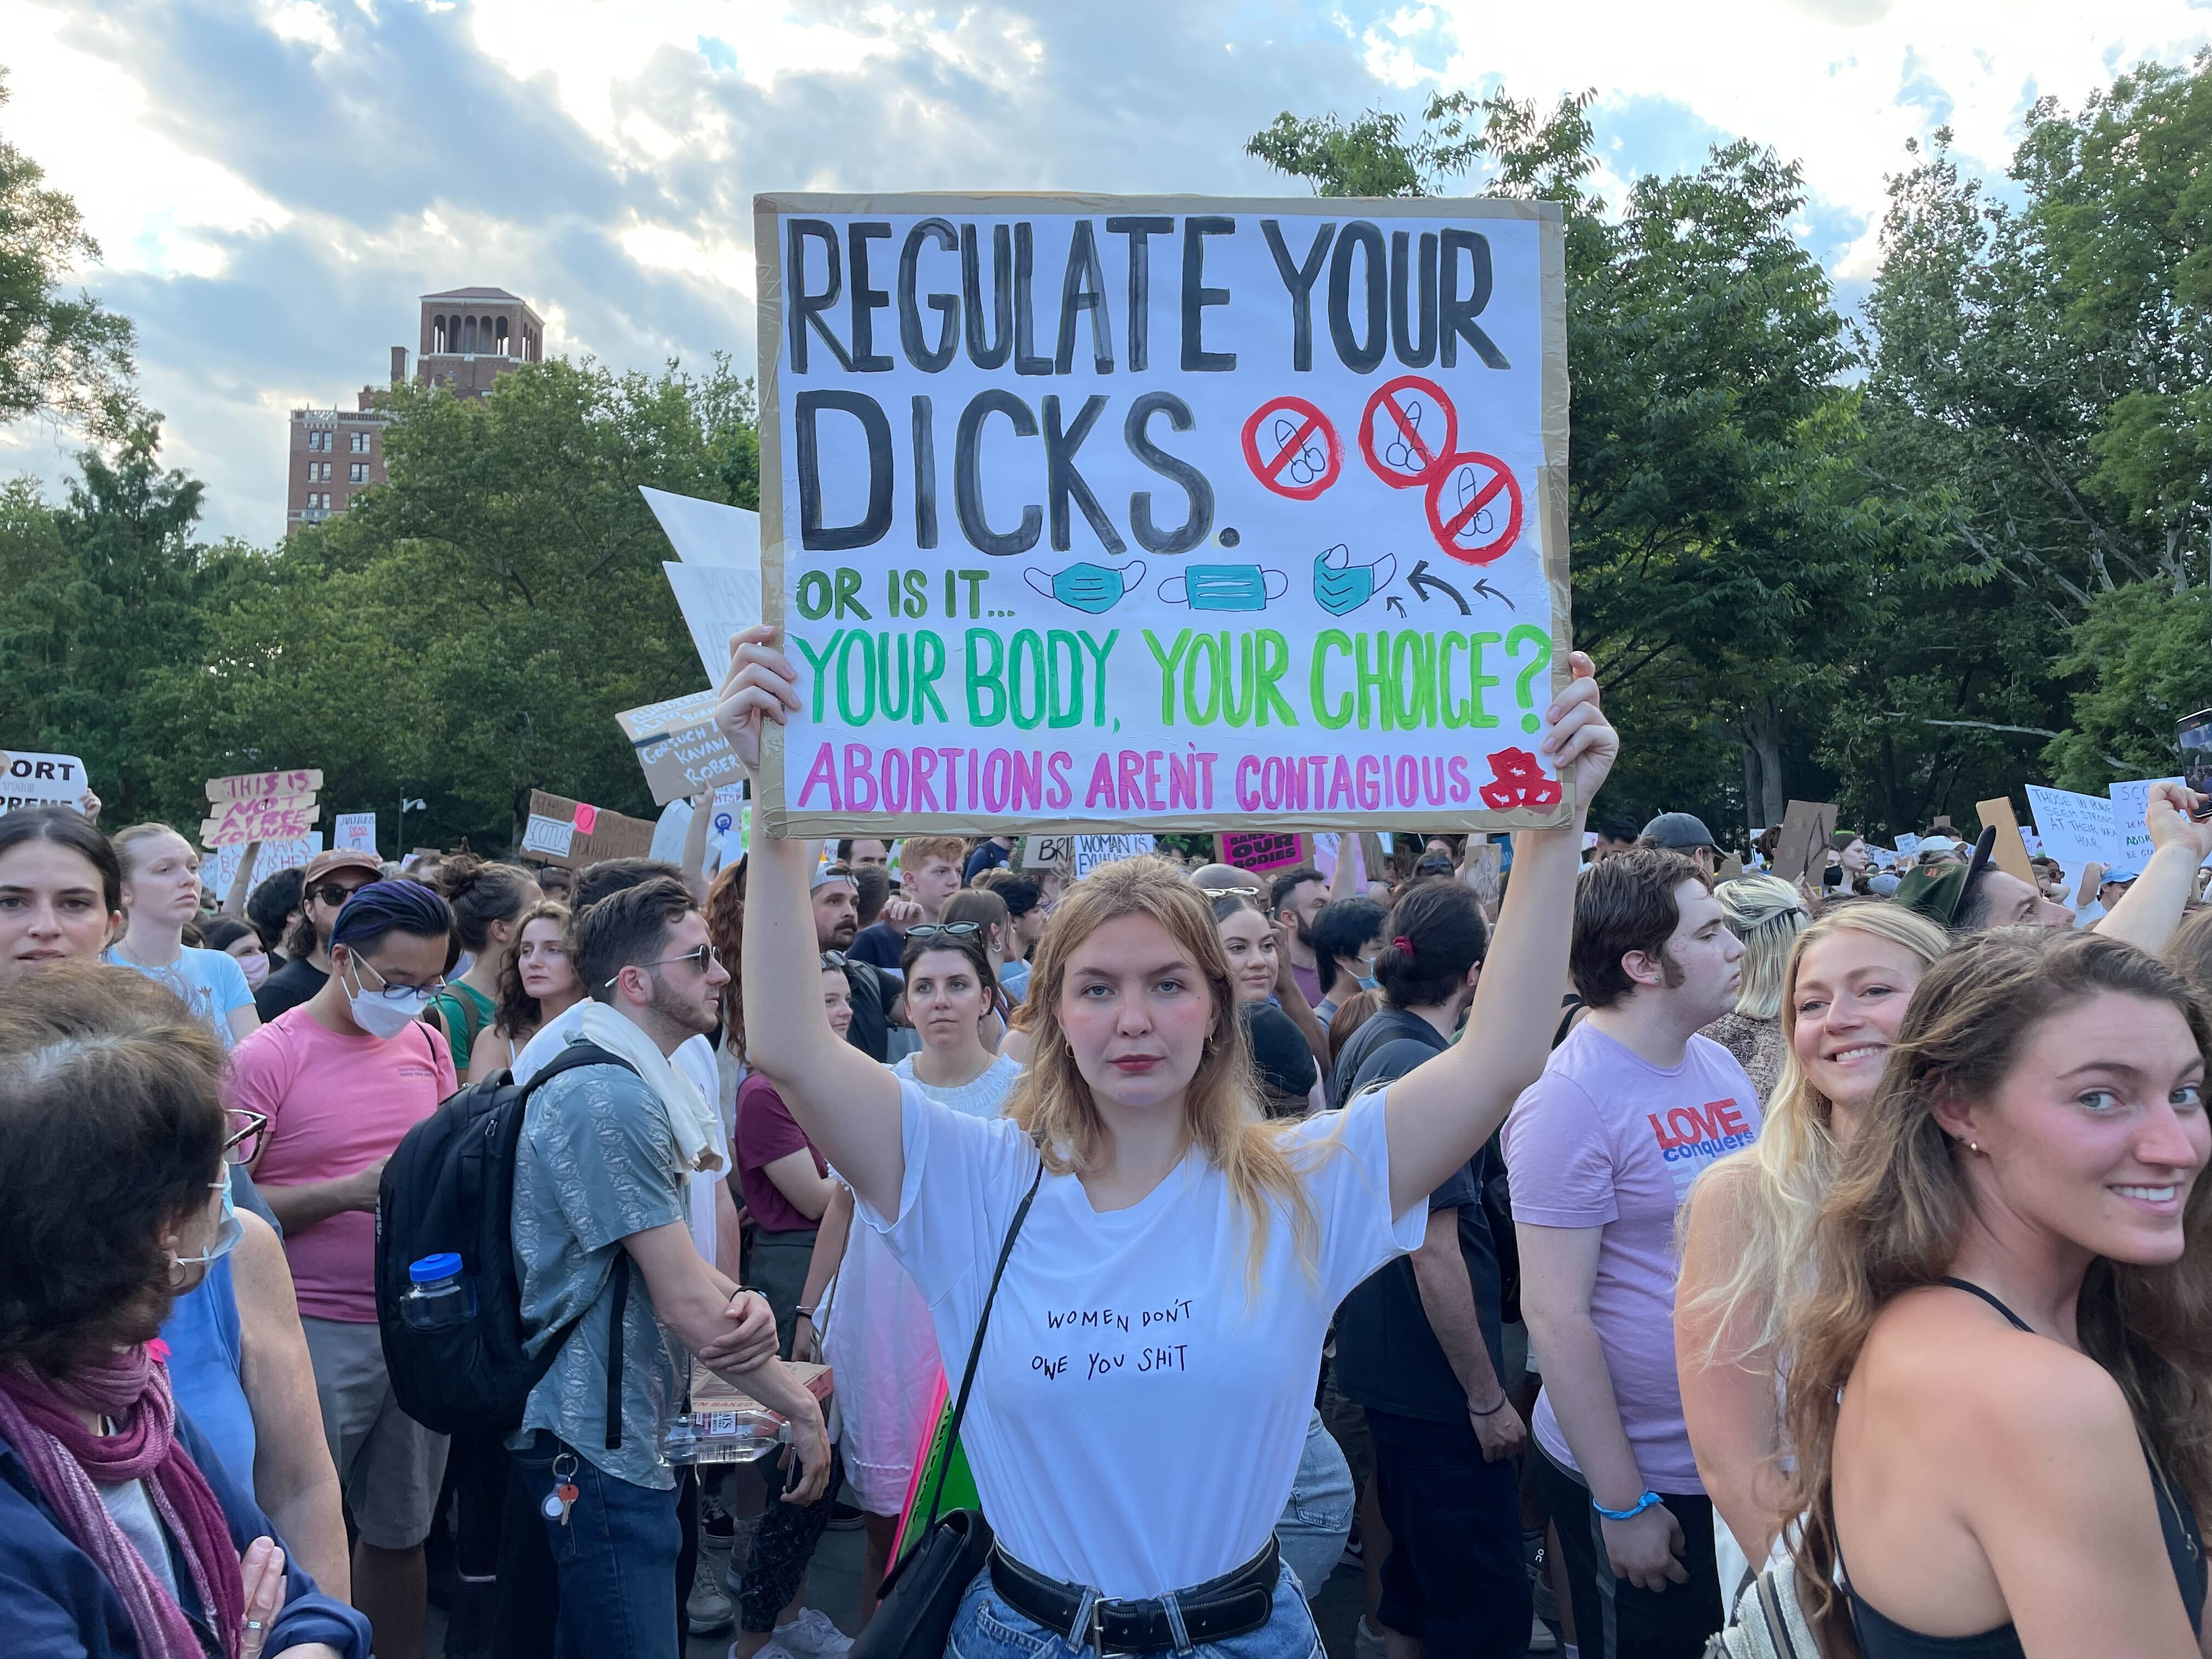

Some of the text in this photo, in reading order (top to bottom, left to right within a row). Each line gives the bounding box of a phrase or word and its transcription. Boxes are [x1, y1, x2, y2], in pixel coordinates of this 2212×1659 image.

[786, 217, 1510, 376] REGULATE YOUR
[795, 388, 1241, 556] DICKS.
[797, 567, 1015, 620] OR IS IT...
[791, 629, 949, 726] YOUR
[966, 628, 1120, 736] BODY,
[1142, 629, 1299, 730] YOUR
[1311, 623, 1553, 734] CHOICE?
[681, 706, 716, 723] BARR
[641, 726, 706, 764] GORSUCH
[684, 753, 741, 787] ROBER
[797, 742, 1073, 812] ABORTIONS
[1235, 755, 1471, 812] CONTAGIOUS
[222, 772, 309, 799] THIS IS
[224, 795, 298, 819] NOT
[2032, 789, 2113, 813] THOSE IN POWE
[219, 817, 240, 833] A
[2043, 806, 2115, 825] SEEM STRONG
[2050, 817, 2118, 837] AT THEIR WEA
[2125, 820, 2146, 829] DEM
[210, 825, 311, 845] COUNTRY
[527, 820, 571, 850] SCOTUS
[1080, 834, 1148, 854] WOMAN IS
[1231, 834, 1294, 858] OUR
[2074, 834, 2102, 849] HOUR
[2126, 834, 2153, 846] ABOR
[267, 855, 276, 870] IS
[1233, 847, 1296, 868] BODIES
[2126, 849, 2154, 859] BE GU
[1647, 1097, 1751, 1150] LOVE
[1663, 1131, 1756, 1163] conquers
[1048, 1299, 1193, 1333] WOMEN DON'T
[1088, 1352, 1125, 1381] YOU
